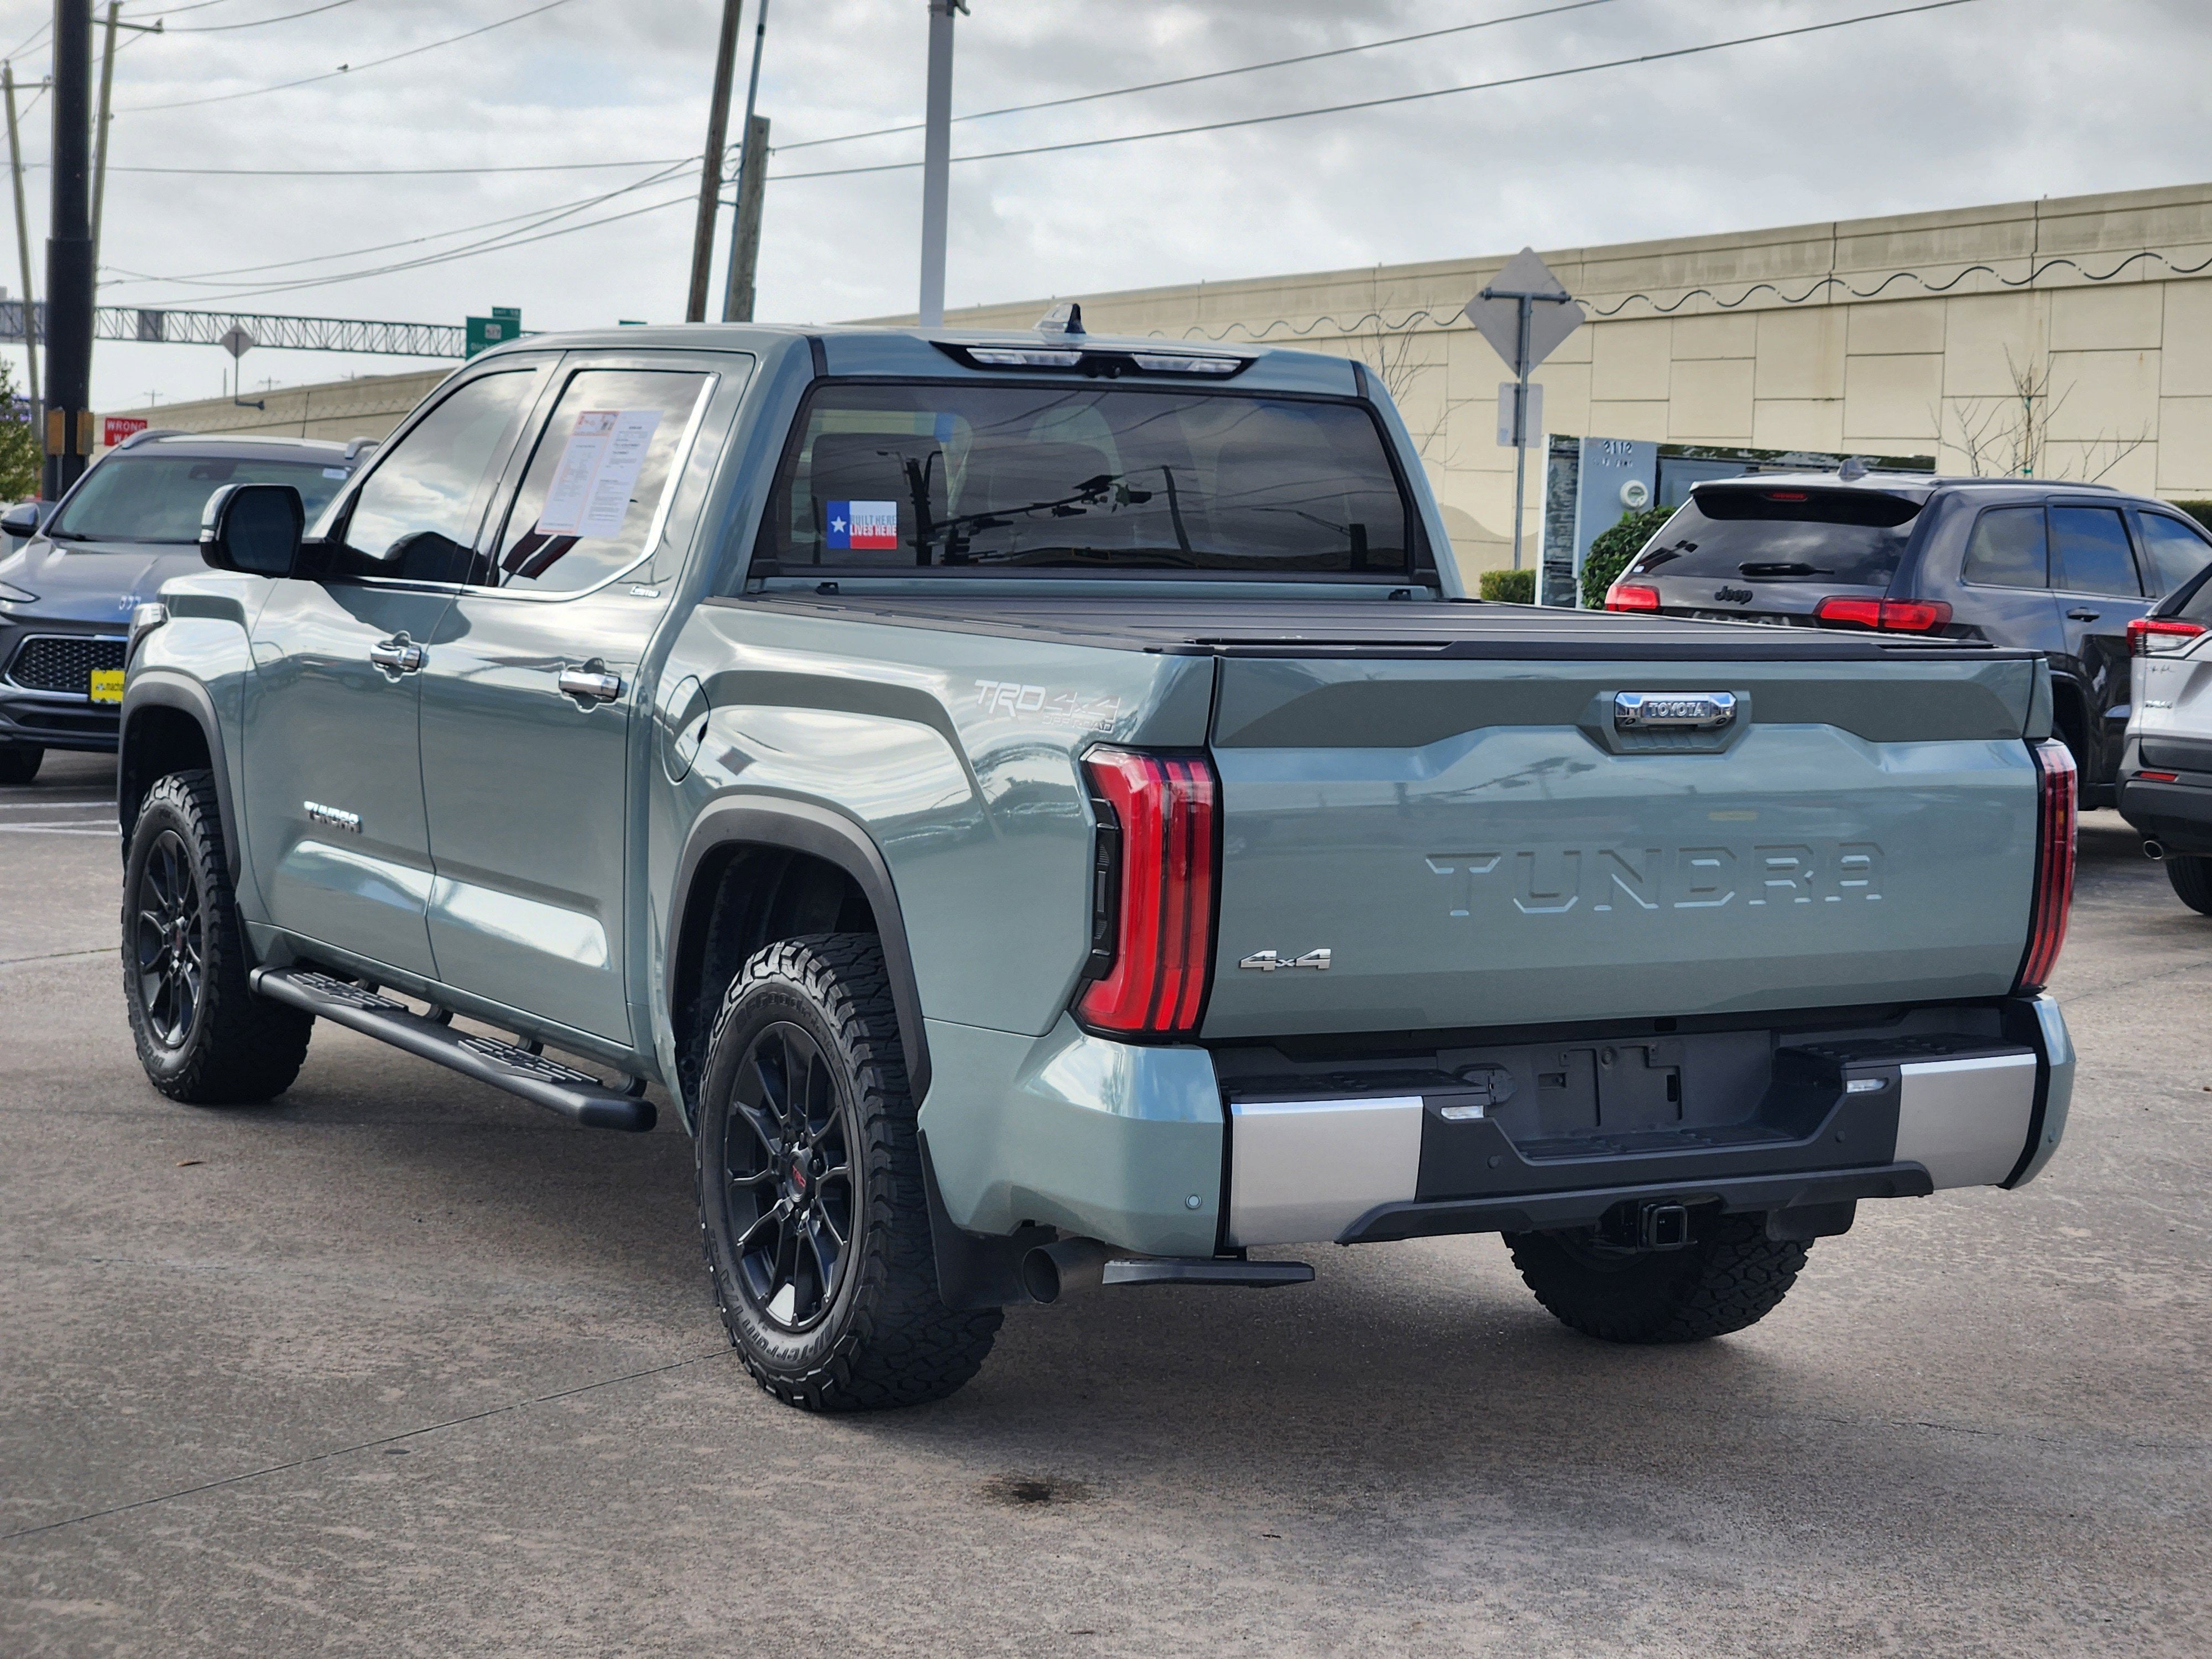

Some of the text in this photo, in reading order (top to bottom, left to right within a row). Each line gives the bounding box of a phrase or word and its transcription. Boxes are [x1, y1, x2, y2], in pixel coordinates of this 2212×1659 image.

[107, 420, 145, 431] WRONG
[851, 515, 896, 525] BUILT HERE
[851, 525, 897, 536] LIVES HERE
[1715, 586, 1753, 605] Jeep
[974, 679, 1046, 717] TRD
[1648, 702, 1705, 717] TOYOTA
[304, 801, 363, 834] TUNDRA
[1425, 841, 1886, 916] TUNDRA
[1240, 943, 1332, 972] 4x4
